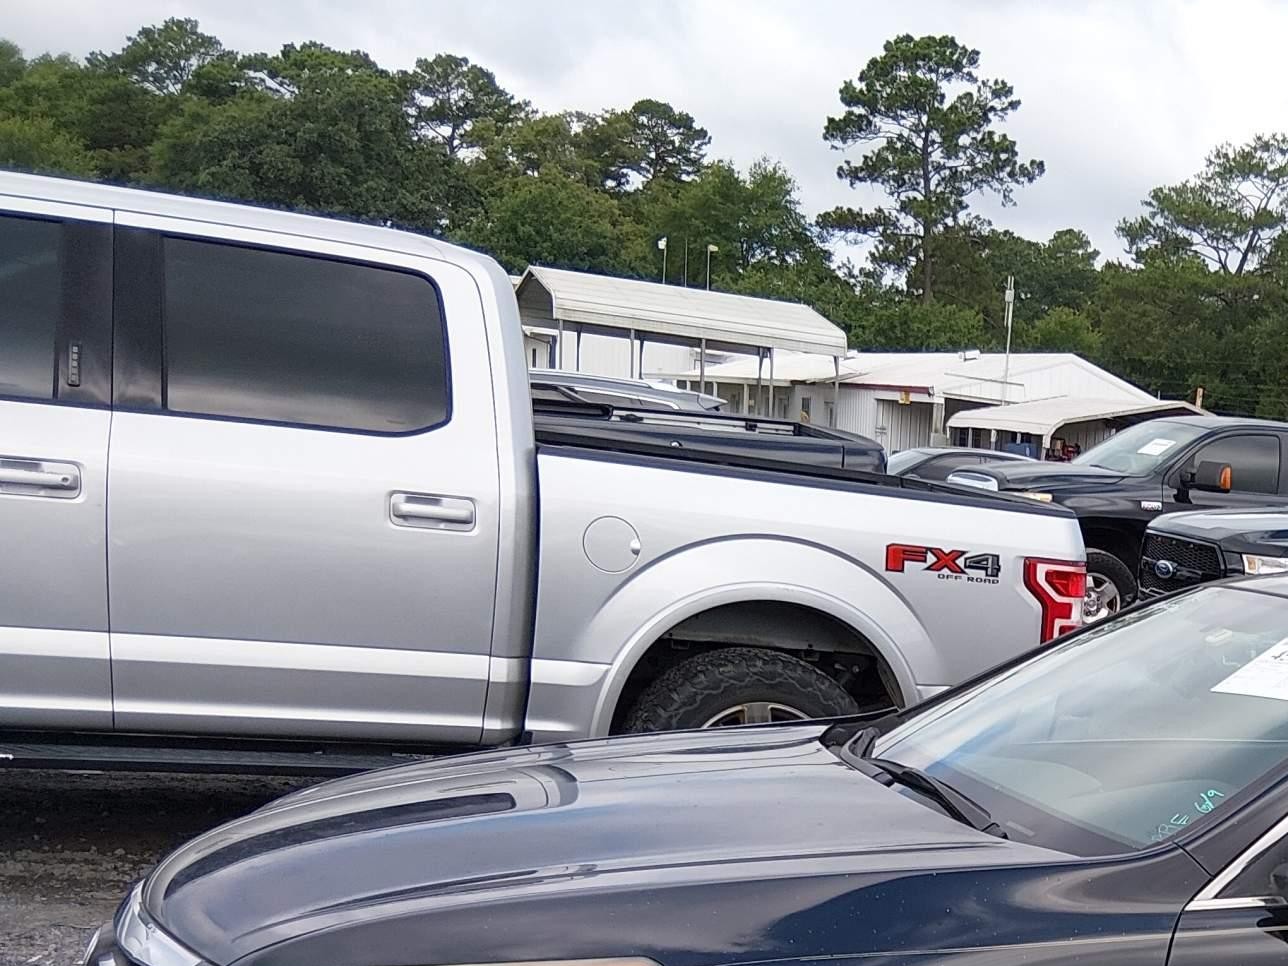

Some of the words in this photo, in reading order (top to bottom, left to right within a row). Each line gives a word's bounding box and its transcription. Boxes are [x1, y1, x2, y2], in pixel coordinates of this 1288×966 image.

[885, 543, 1001, 578] FX4
[937, 573, 963, 581] OFF
[967, 576, 1000, 585] ROAD
